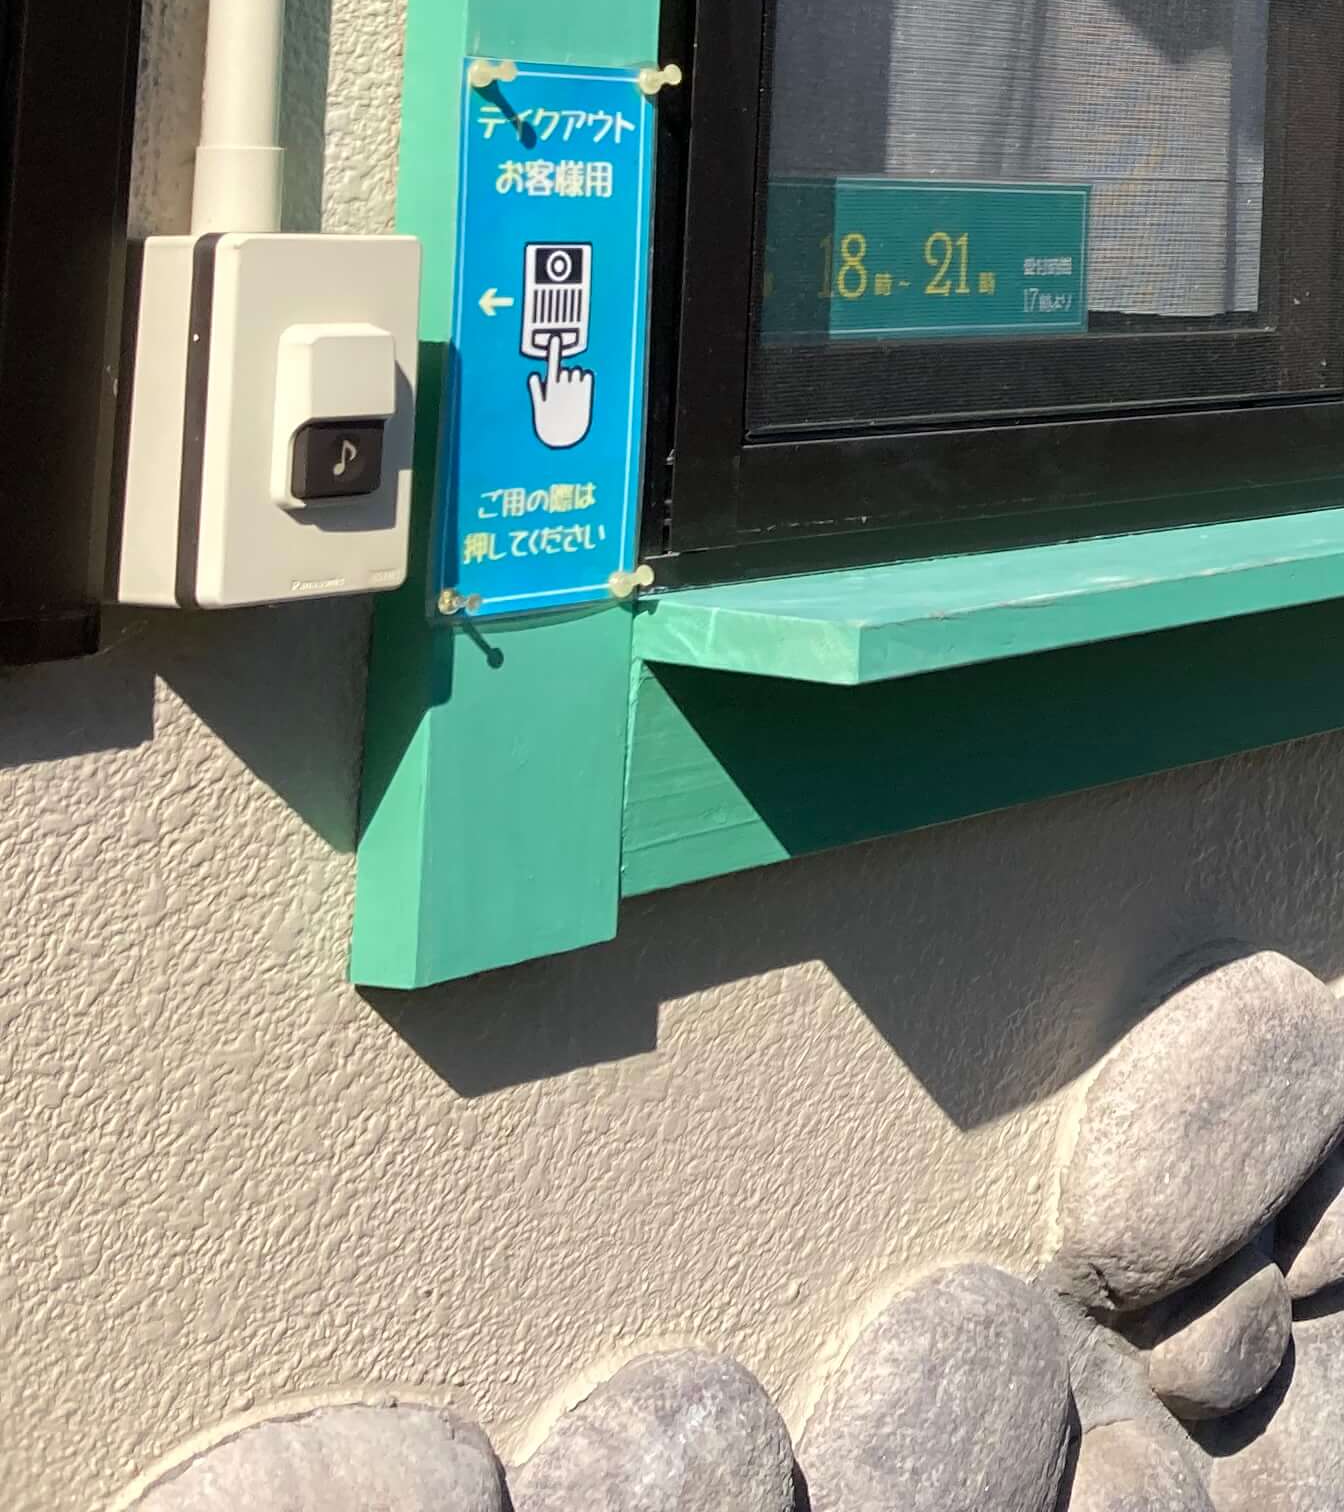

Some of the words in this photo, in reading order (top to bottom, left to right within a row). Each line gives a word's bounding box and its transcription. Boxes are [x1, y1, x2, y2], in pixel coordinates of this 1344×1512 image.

[476, 105, 636, 146] テイクアウト
[494, 158, 614, 199] お客様用
[477, 480, 598, 521] ご用の際は
[461, 525, 608, 565] 押してください
